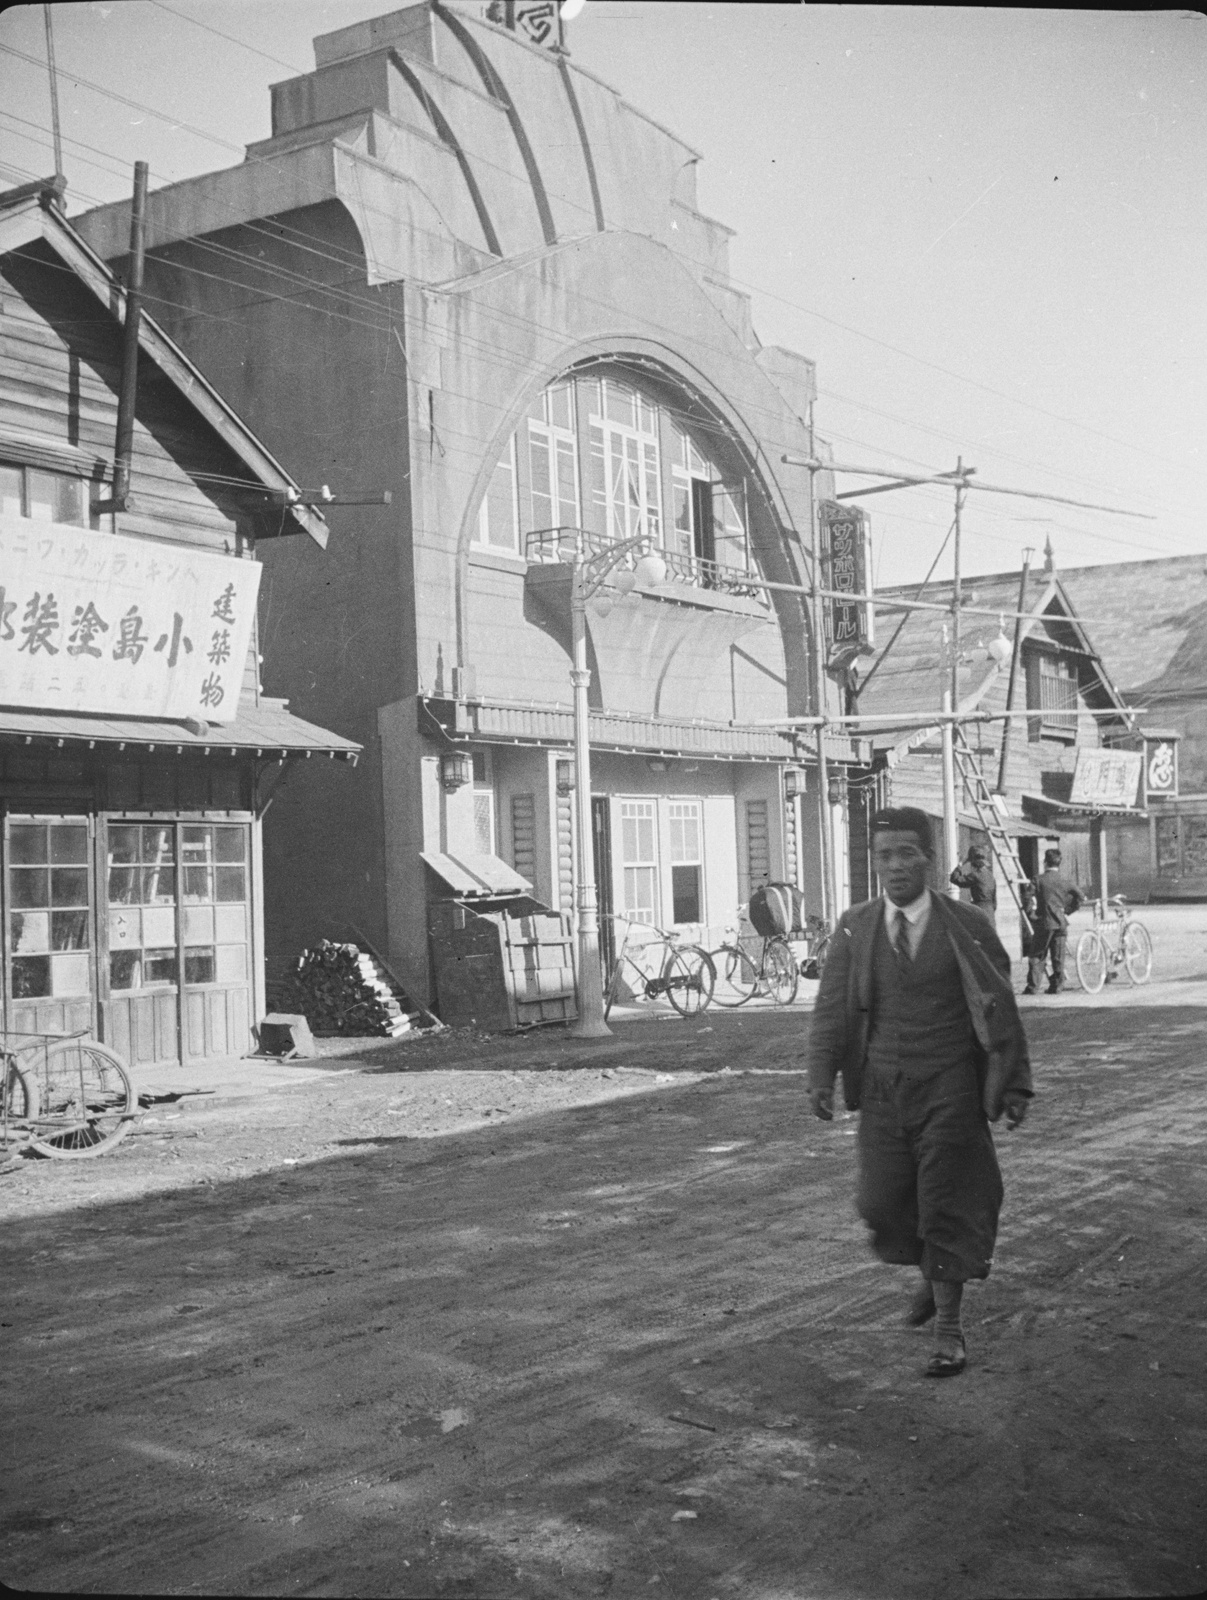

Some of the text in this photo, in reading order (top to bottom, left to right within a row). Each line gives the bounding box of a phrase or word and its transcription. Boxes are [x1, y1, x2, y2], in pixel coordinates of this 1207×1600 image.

[199, 582, 237, 708] 建築物
[117, 915, 127, 938] 入口
